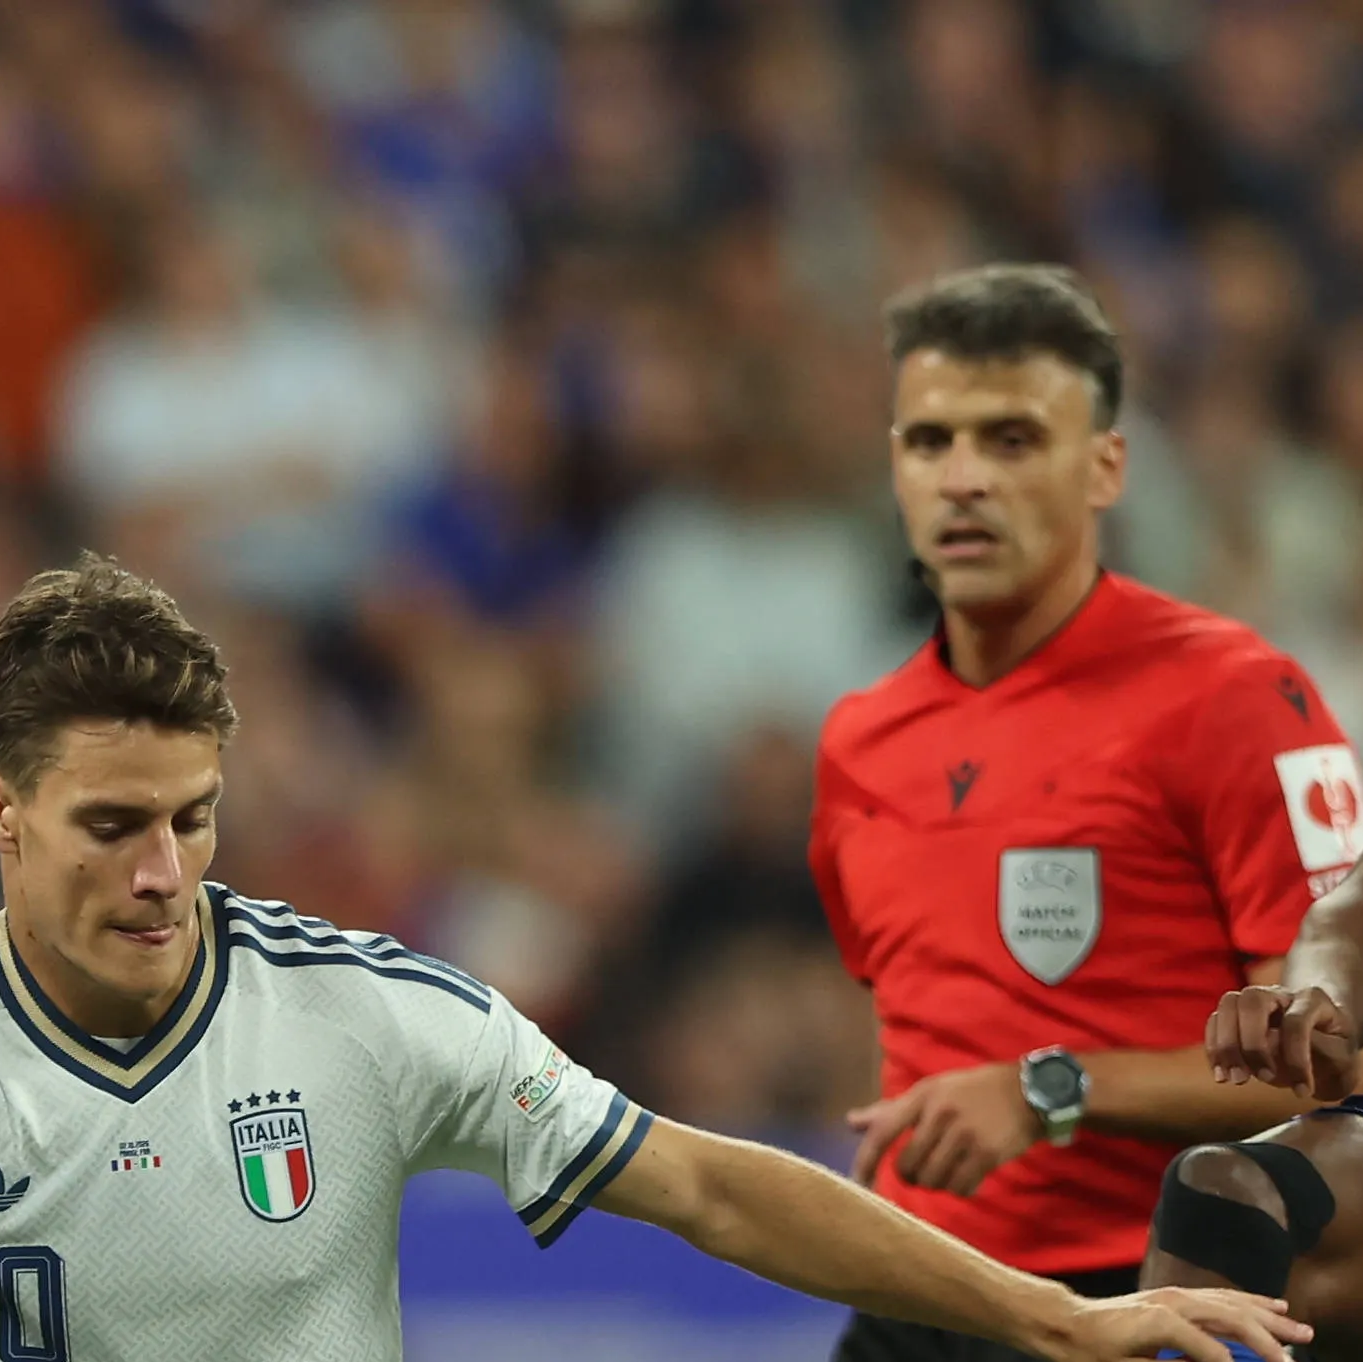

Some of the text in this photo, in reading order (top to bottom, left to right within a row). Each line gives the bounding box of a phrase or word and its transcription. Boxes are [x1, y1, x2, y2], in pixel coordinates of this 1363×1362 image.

[510, 1075, 534, 1100] UEFA
[238, 1117, 301, 1146] ITALIA
[262, 1141, 282, 1152] FIGC
